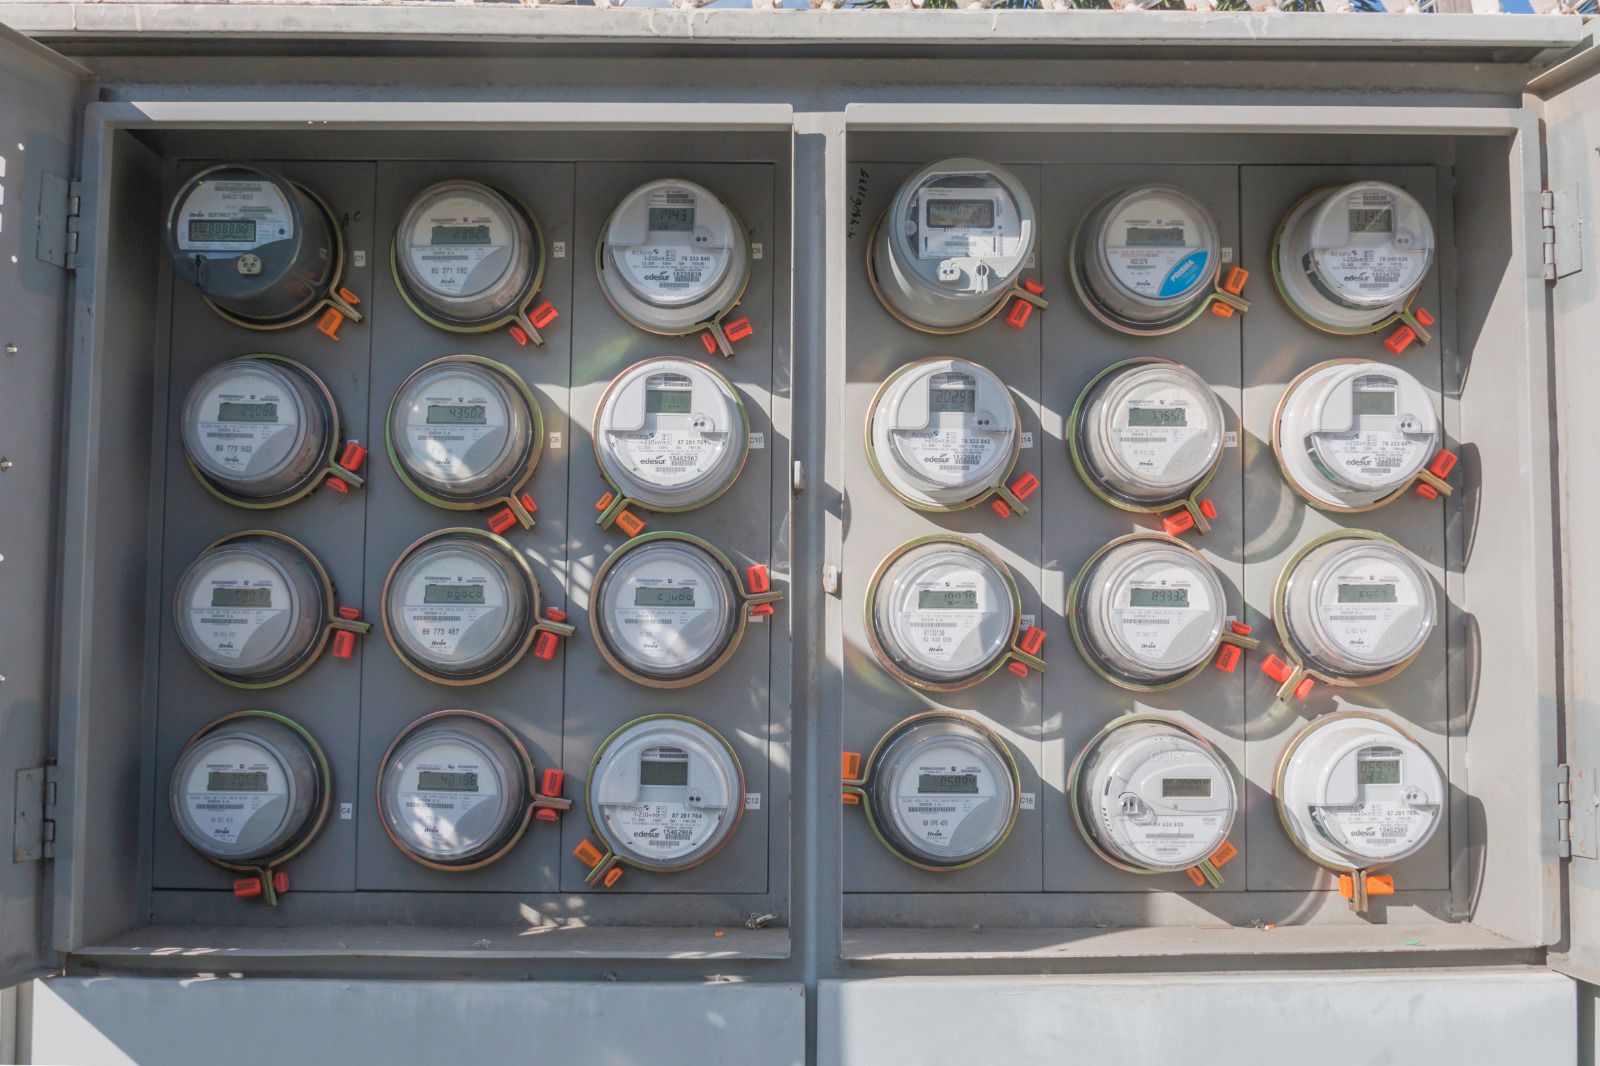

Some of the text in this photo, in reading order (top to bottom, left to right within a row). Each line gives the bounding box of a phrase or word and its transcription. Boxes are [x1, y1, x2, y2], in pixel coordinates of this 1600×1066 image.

[354, 254, 365, 262] C1
[1171, 260, 1195, 282] PRISMA
[644, 272, 670, 281] edesur
[1344, 273, 1370, 281] edesur
[640, 456, 666, 464] edesur
[924, 454, 950, 462] edesur
[1346, 457, 1372, 466] edesur
[1152, 590, 1185, 601] 89332
[634, 828, 660, 838] edesur
[1351, 828, 1376, 836] edesur
